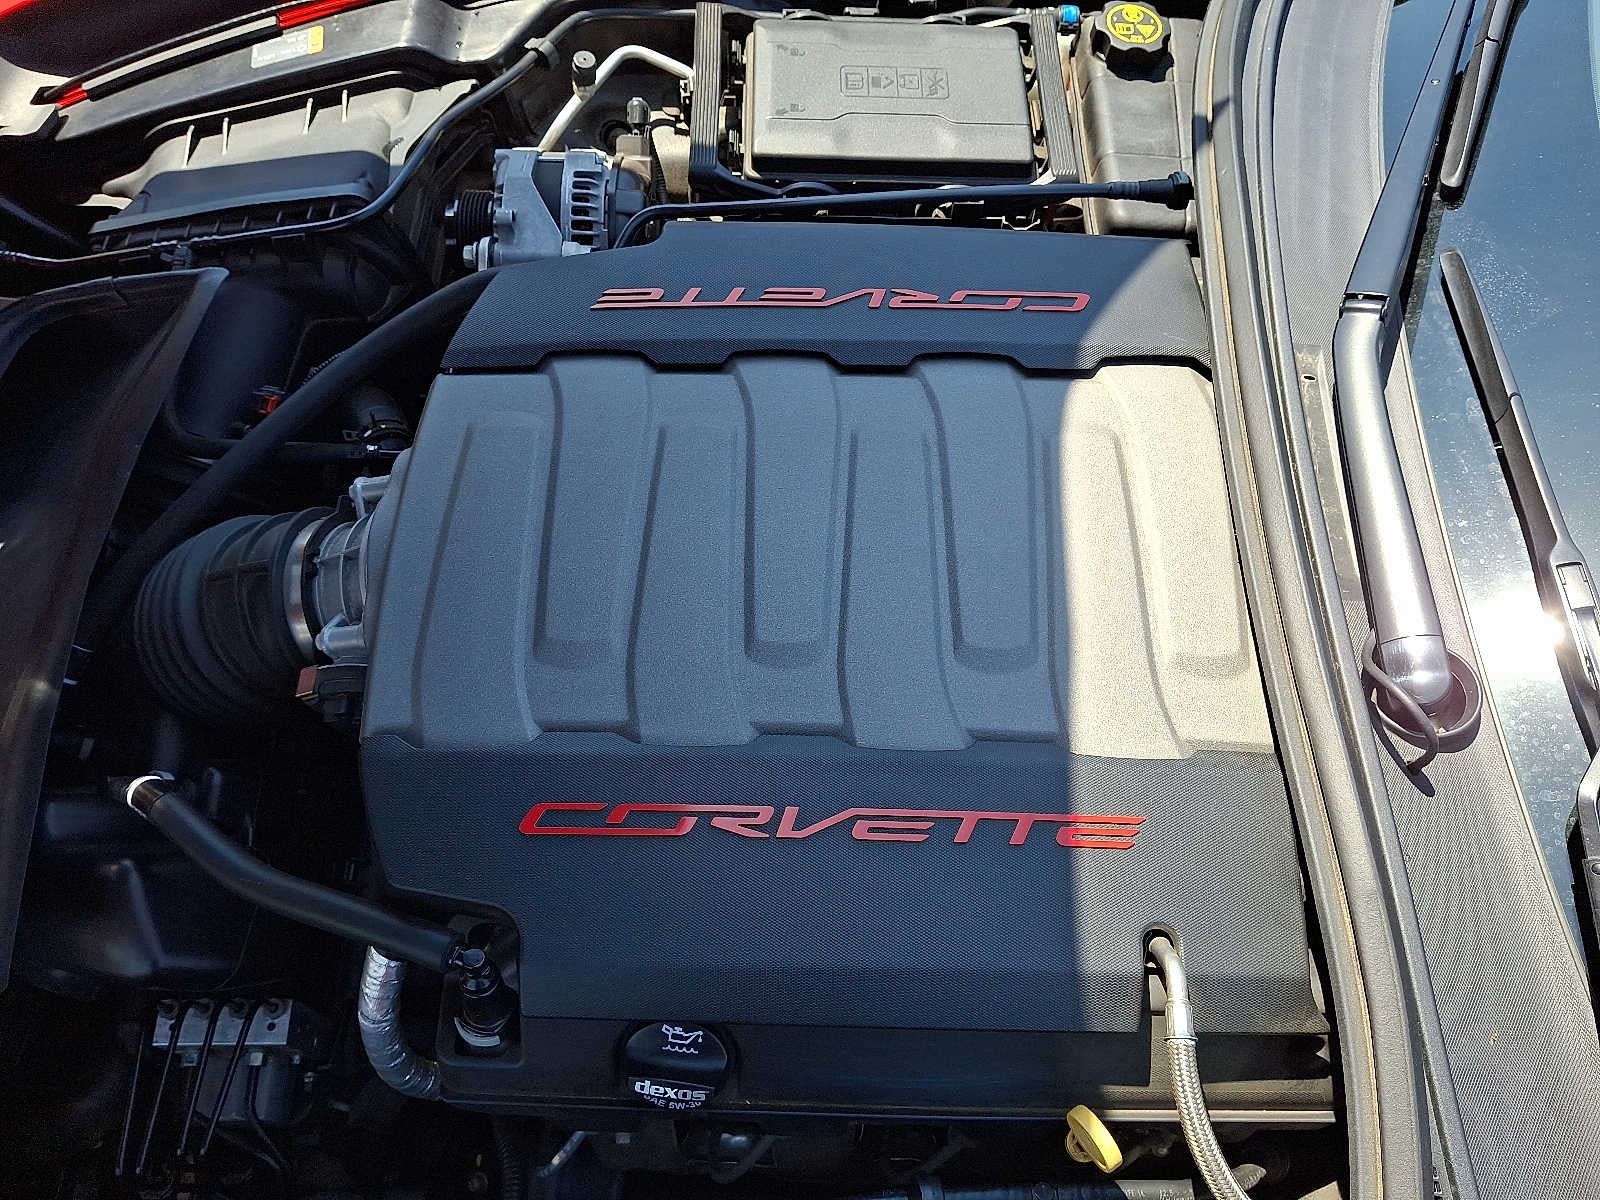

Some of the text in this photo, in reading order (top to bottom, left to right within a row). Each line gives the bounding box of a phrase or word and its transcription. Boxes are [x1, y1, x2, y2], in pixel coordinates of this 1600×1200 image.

[590, 287, 1091, 312] CORVETTE
[519, 802, 1147, 850] CORVETTE
[634, 1080, 710, 1101] dexos
